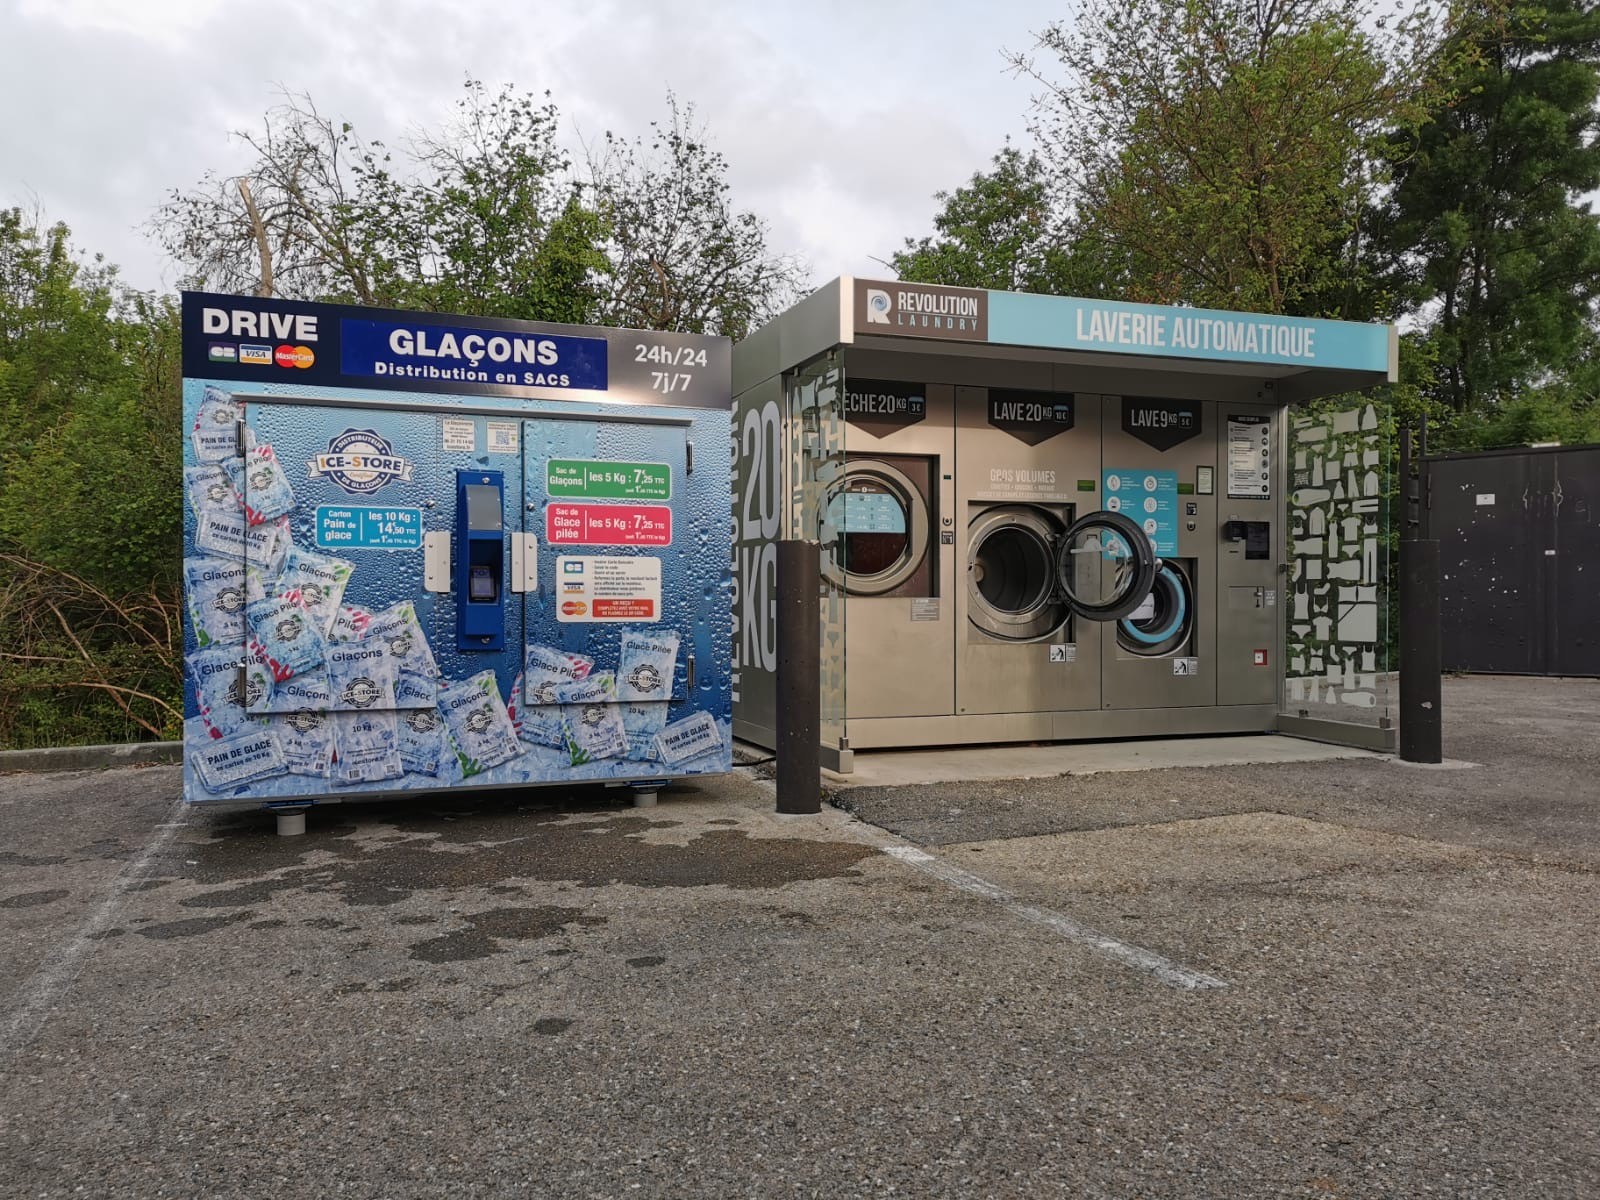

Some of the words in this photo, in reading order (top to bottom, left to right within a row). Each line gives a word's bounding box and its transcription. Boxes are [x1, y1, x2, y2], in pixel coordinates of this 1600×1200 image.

[898, 292, 978, 316] REVOLUTION
[203, 307, 319, 341] DRIVE
[898, 313, 978, 331] LAUNDRY
[1076, 308, 1166, 347] LAVERIE
[1171, 317, 1316, 358] AUTOMATIQUE
[246, 350, 267, 358] VISA
[389, 328, 559, 367] GLAÇONS
[276, 352, 314, 362] MasterCard
[634, 344, 708, 367] 24h/24
[374, 361, 488, 382] Distribution
[495, 373, 517, 384] en
[524, 372, 571, 387] SACS
[651, 371, 692, 394] 7j/7
[878, 395, 895, 413] 20
[896, 397, 907, 409] KG
[994, 401, 1025, 421] LAVE
[1026, 403, 1042, 421] 20
[1131, 409, 1159, 427] LAVE
[1160, 410, 1168, 428] 9
[337, 435, 384, 449] DISTRIBUTEUR
[319, 456, 402, 472] ICE-STORE
[743, 400, 780, 541] 20
[341, 477, 351, 486] DE
[351, 477, 382, 489] GLAÇONS
[549, 476, 583, 487] Glaçons
[589, 472, 603, 481] les
[605, 473, 611, 482] 5
[613, 473, 626, 484] Kg
[1015, 470, 1056, 484] VOLUMES
[328, 510, 352, 518] Carton
[369, 512, 382, 521] les
[386, 512, 396, 521] 10
[398, 512, 410, 523] Kg
[324, 519, 345, 528] Pain
[554, 517, 581, 527] Glace
[589, 518, 603, 527] les
[605, 518, 611, 527] 5
[613, 519, 626, 530] Kg
[210, 521, 228, 532] PAIN
[231, 527, 241, 536] DE
[243, 530, 268, 543] GLACE
[325, 530, 352, 541] glace
[556, 529, 579, 539] pilée
[203, 567, 246, 581] Glaçons
[299, 563, 337, 582] Glaçons
[743, 542, 777, 673] KG
[254, 609, 279, 623] Glace
[373, 618, 409, 636] Glaçons
[626, 640, 650, 651] Glace
[332, 648, 383, 662] Glaçons
[202, 660, 238, 675] Glace
[531, 658, 558, 673] Glace
[343, 689, 381, 699] ICE-STORE
[451, 689, 488, 709] Glaçons
[664, 735, 681, 746] PAIN
[681, 731, 690, 740] DE
[691, 723, 711, 736] GLACE
[207, 752, 229, 765] PAIN
[231, 748, 242, 759] DE
[244, 739, 272, 755] GLACE
